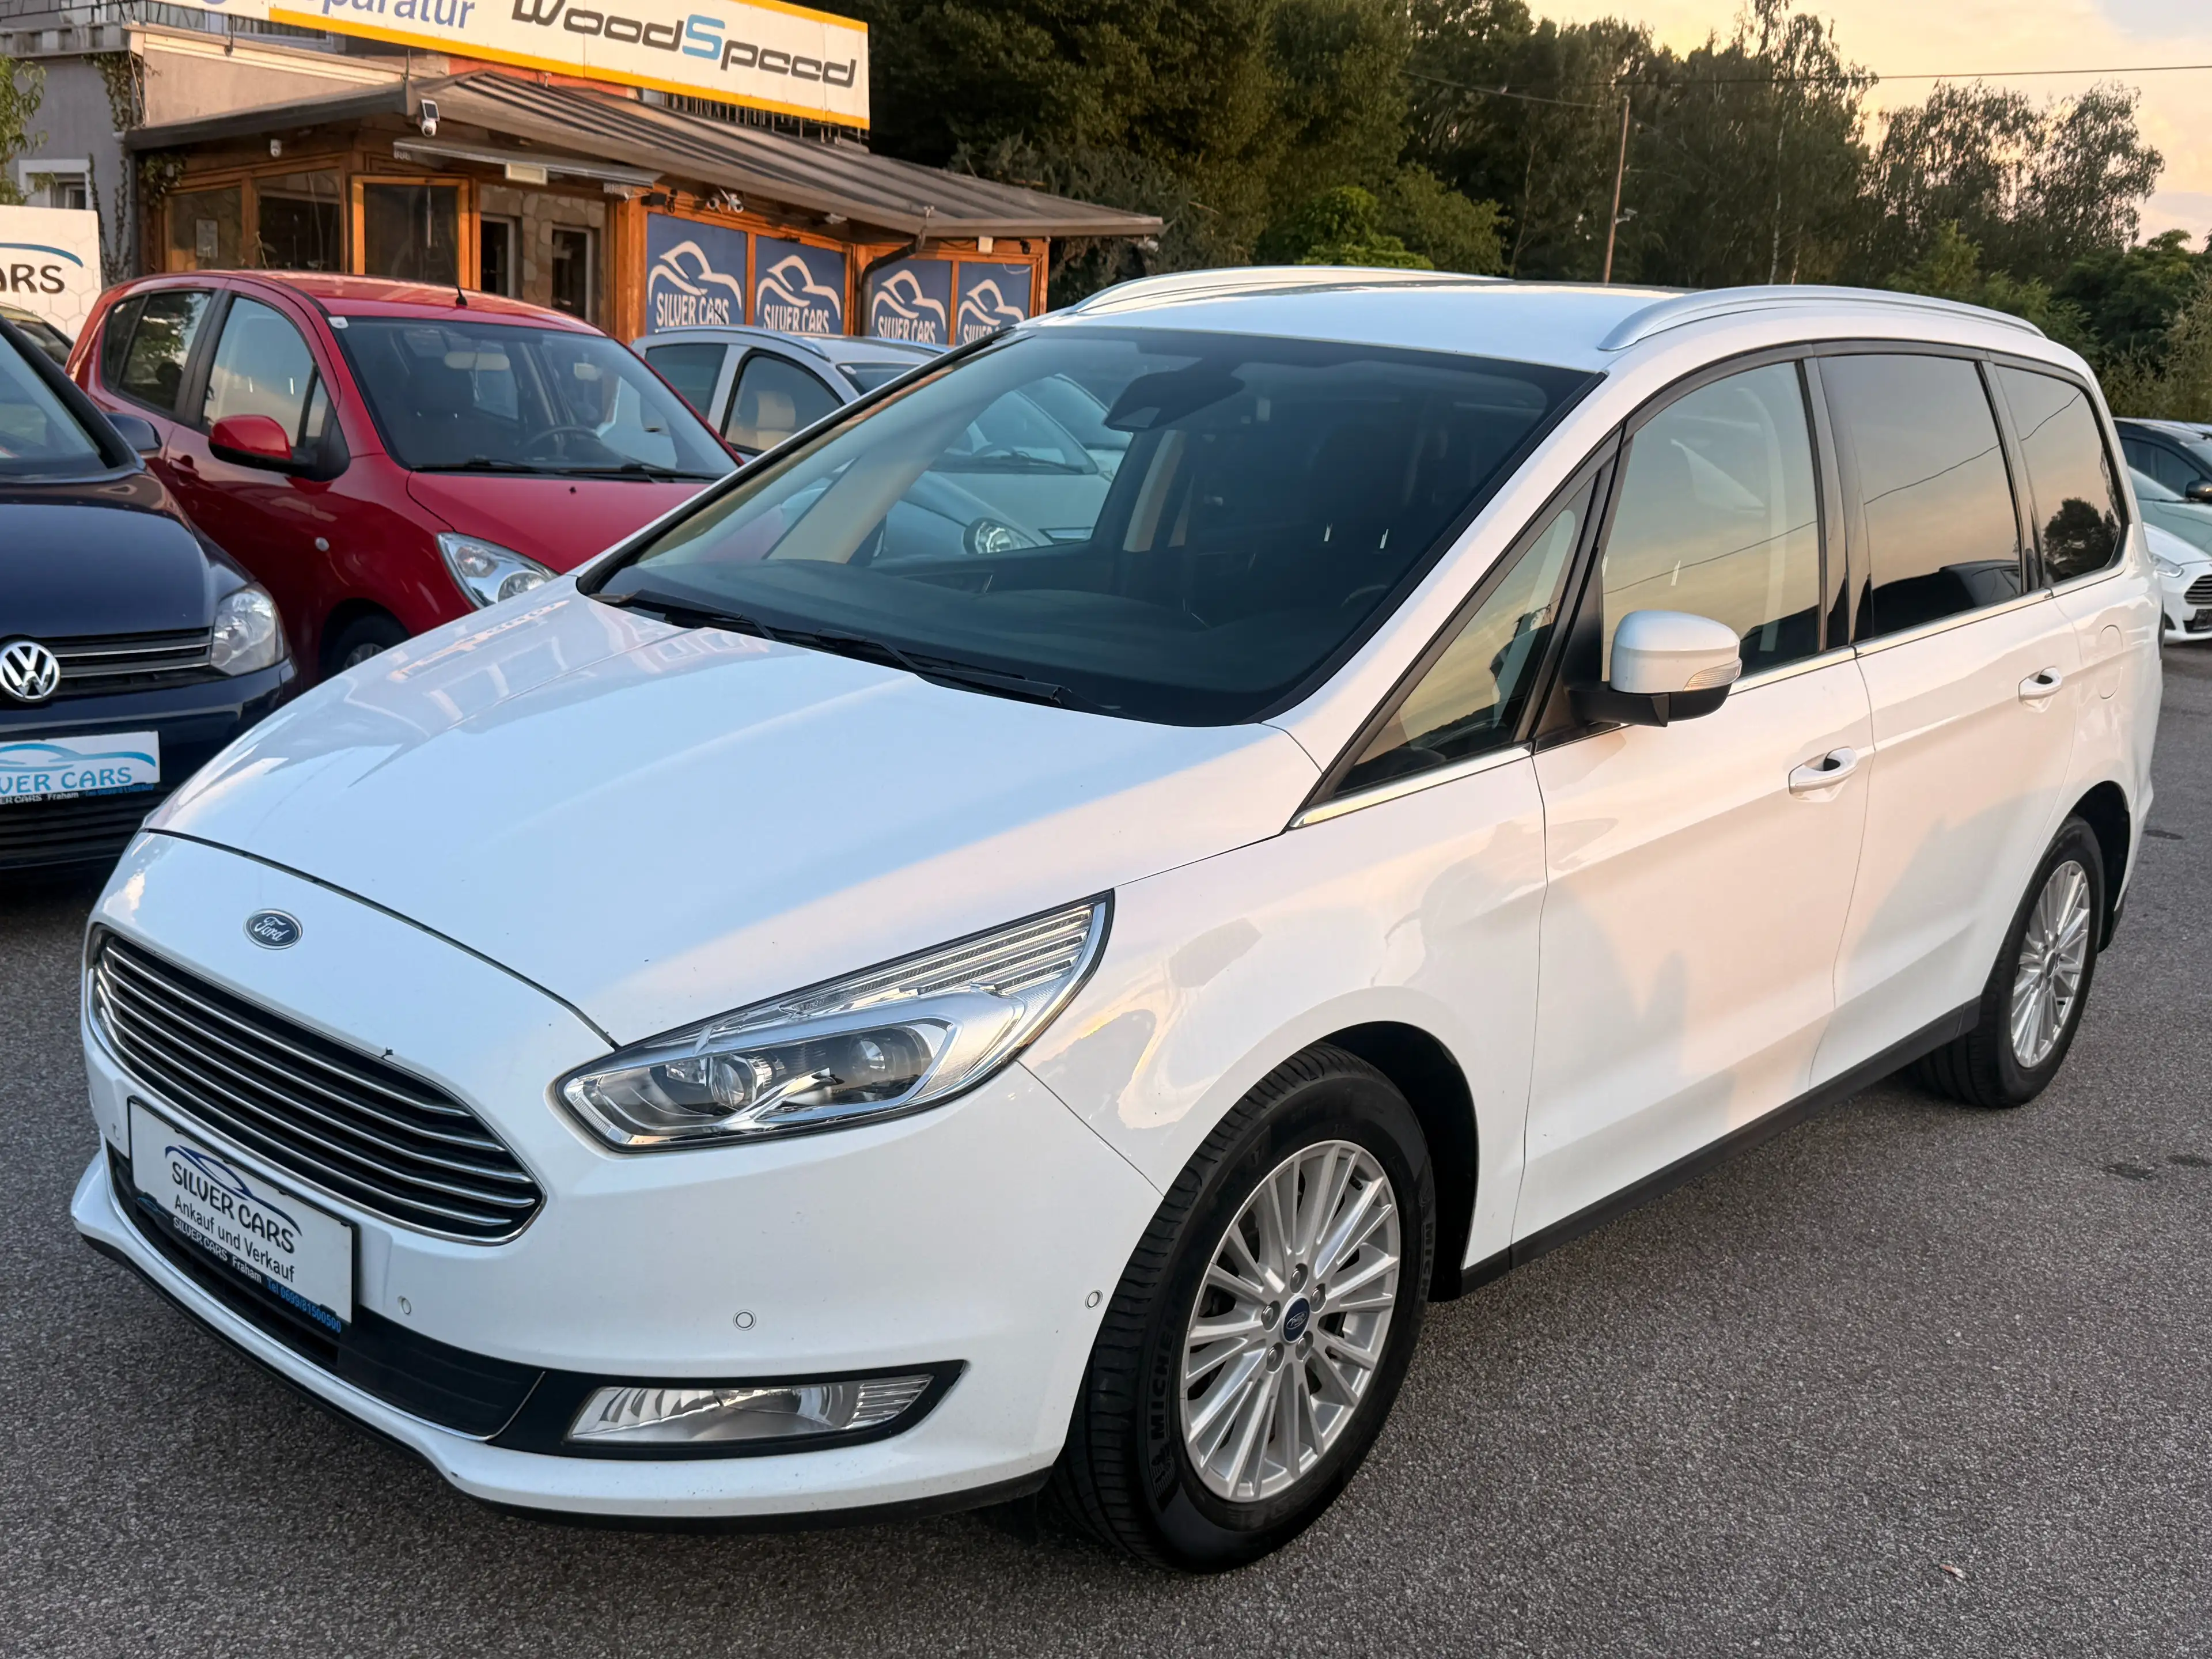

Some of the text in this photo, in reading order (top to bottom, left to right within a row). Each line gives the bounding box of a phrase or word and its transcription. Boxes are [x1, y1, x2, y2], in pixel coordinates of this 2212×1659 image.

[0, 263, 65, 294] RS
[656, 293, 730, 327] SILVER CARS
[61, 767, 132, 789] CARS
[48, 791, 79, 801] Fraham
[254, 916, 290, 941] Ford
[172, 1161, 295, 1254] SILVER CARS
[175, 1194, 295, 1283] Ankauf und Verkauf
[173, 1216, 203, 1245] SILVER
[203, 1238, 228, 1261] CARS
[232, 1255, 262, 1283] Fraham
[267, 1277, 279, 1294] Tel
